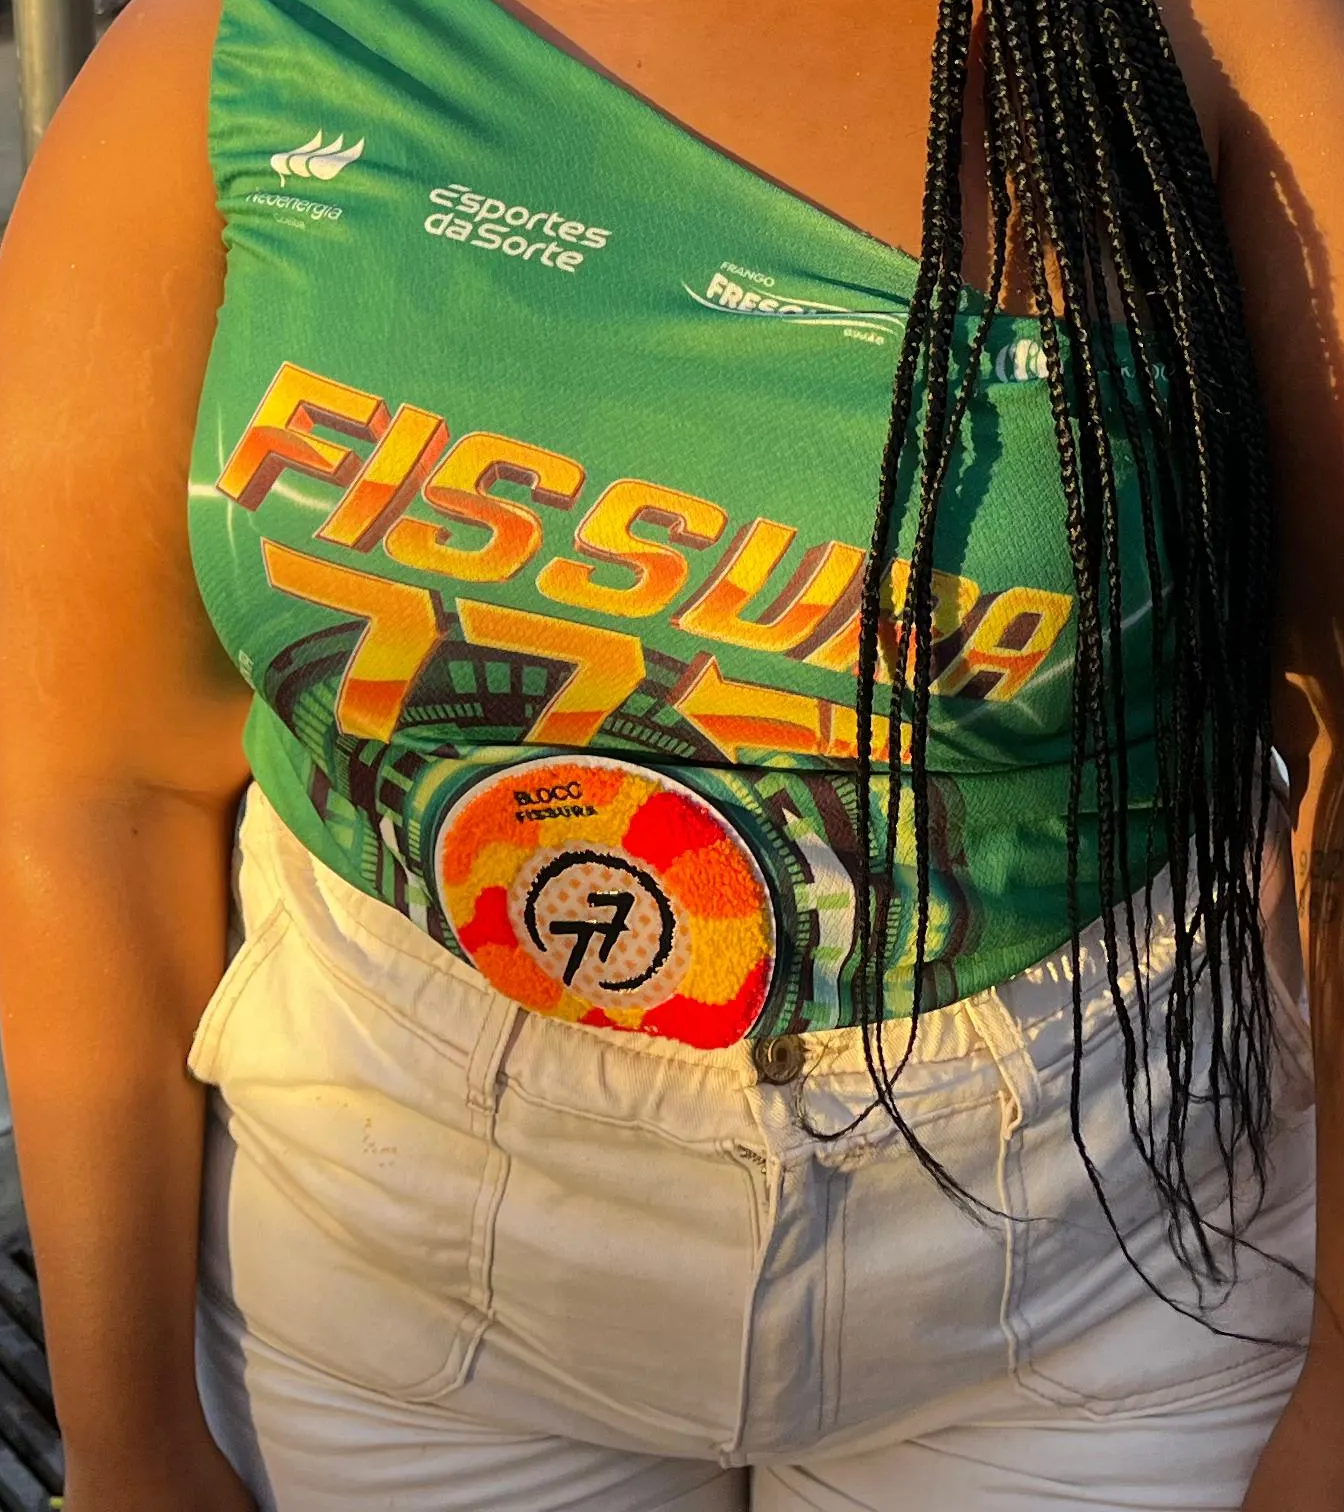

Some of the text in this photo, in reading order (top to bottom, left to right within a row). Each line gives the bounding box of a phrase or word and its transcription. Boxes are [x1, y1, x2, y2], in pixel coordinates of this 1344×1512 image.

[429, 183, 613, 249] Esportes
[719, 261, 776, 288] FRANGO
[215, 360, 1074, 704] FISSURA
